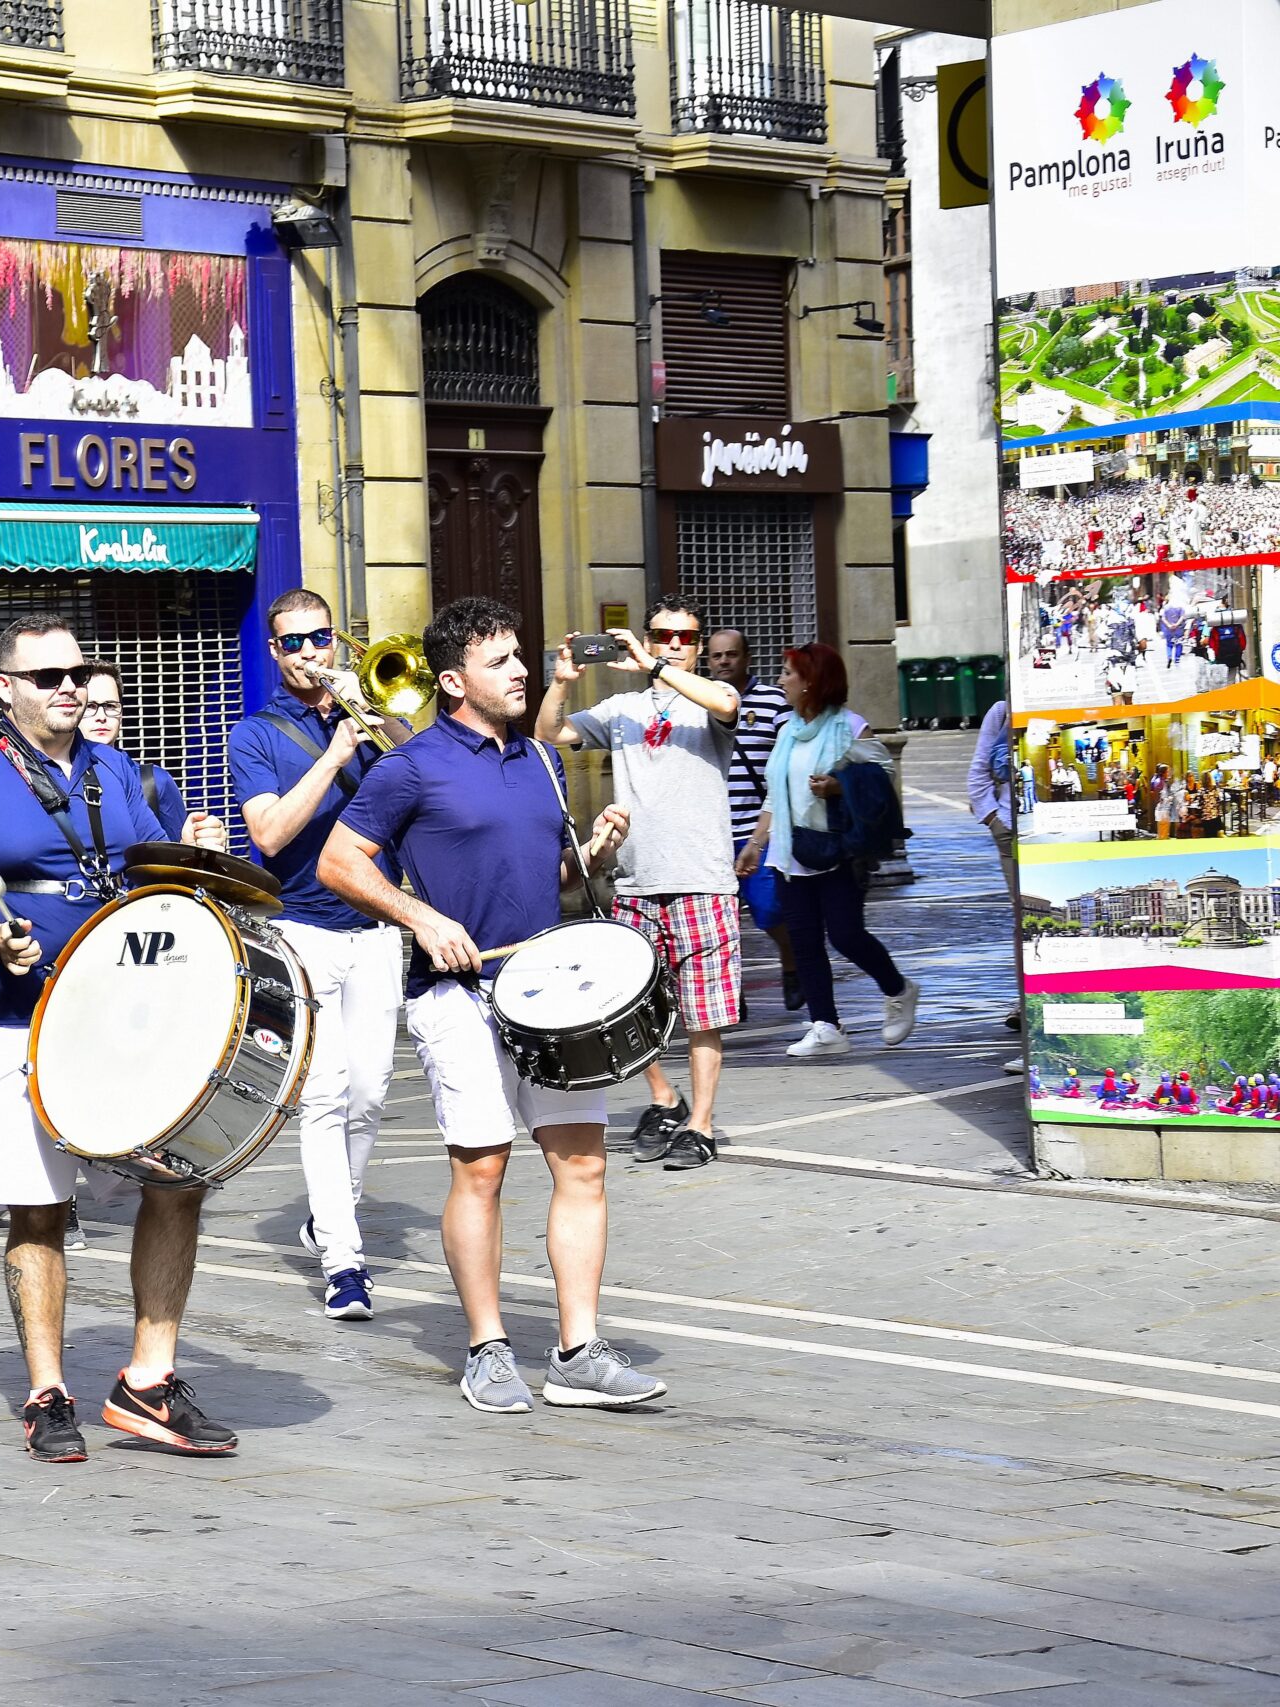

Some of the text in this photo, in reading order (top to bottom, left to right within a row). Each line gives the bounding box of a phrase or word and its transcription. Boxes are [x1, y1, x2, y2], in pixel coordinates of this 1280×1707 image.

[1156, 130, 1225, 165] Iruña
[1009, 149, 1131, 191] Pamplona
[1068, 172, 1132, 198] me gusta!
[1156, 157, 1225, 182] atsegin dut!
[20, 432, 196, 490] FLORES
[116, 931, 176, 967] NP
